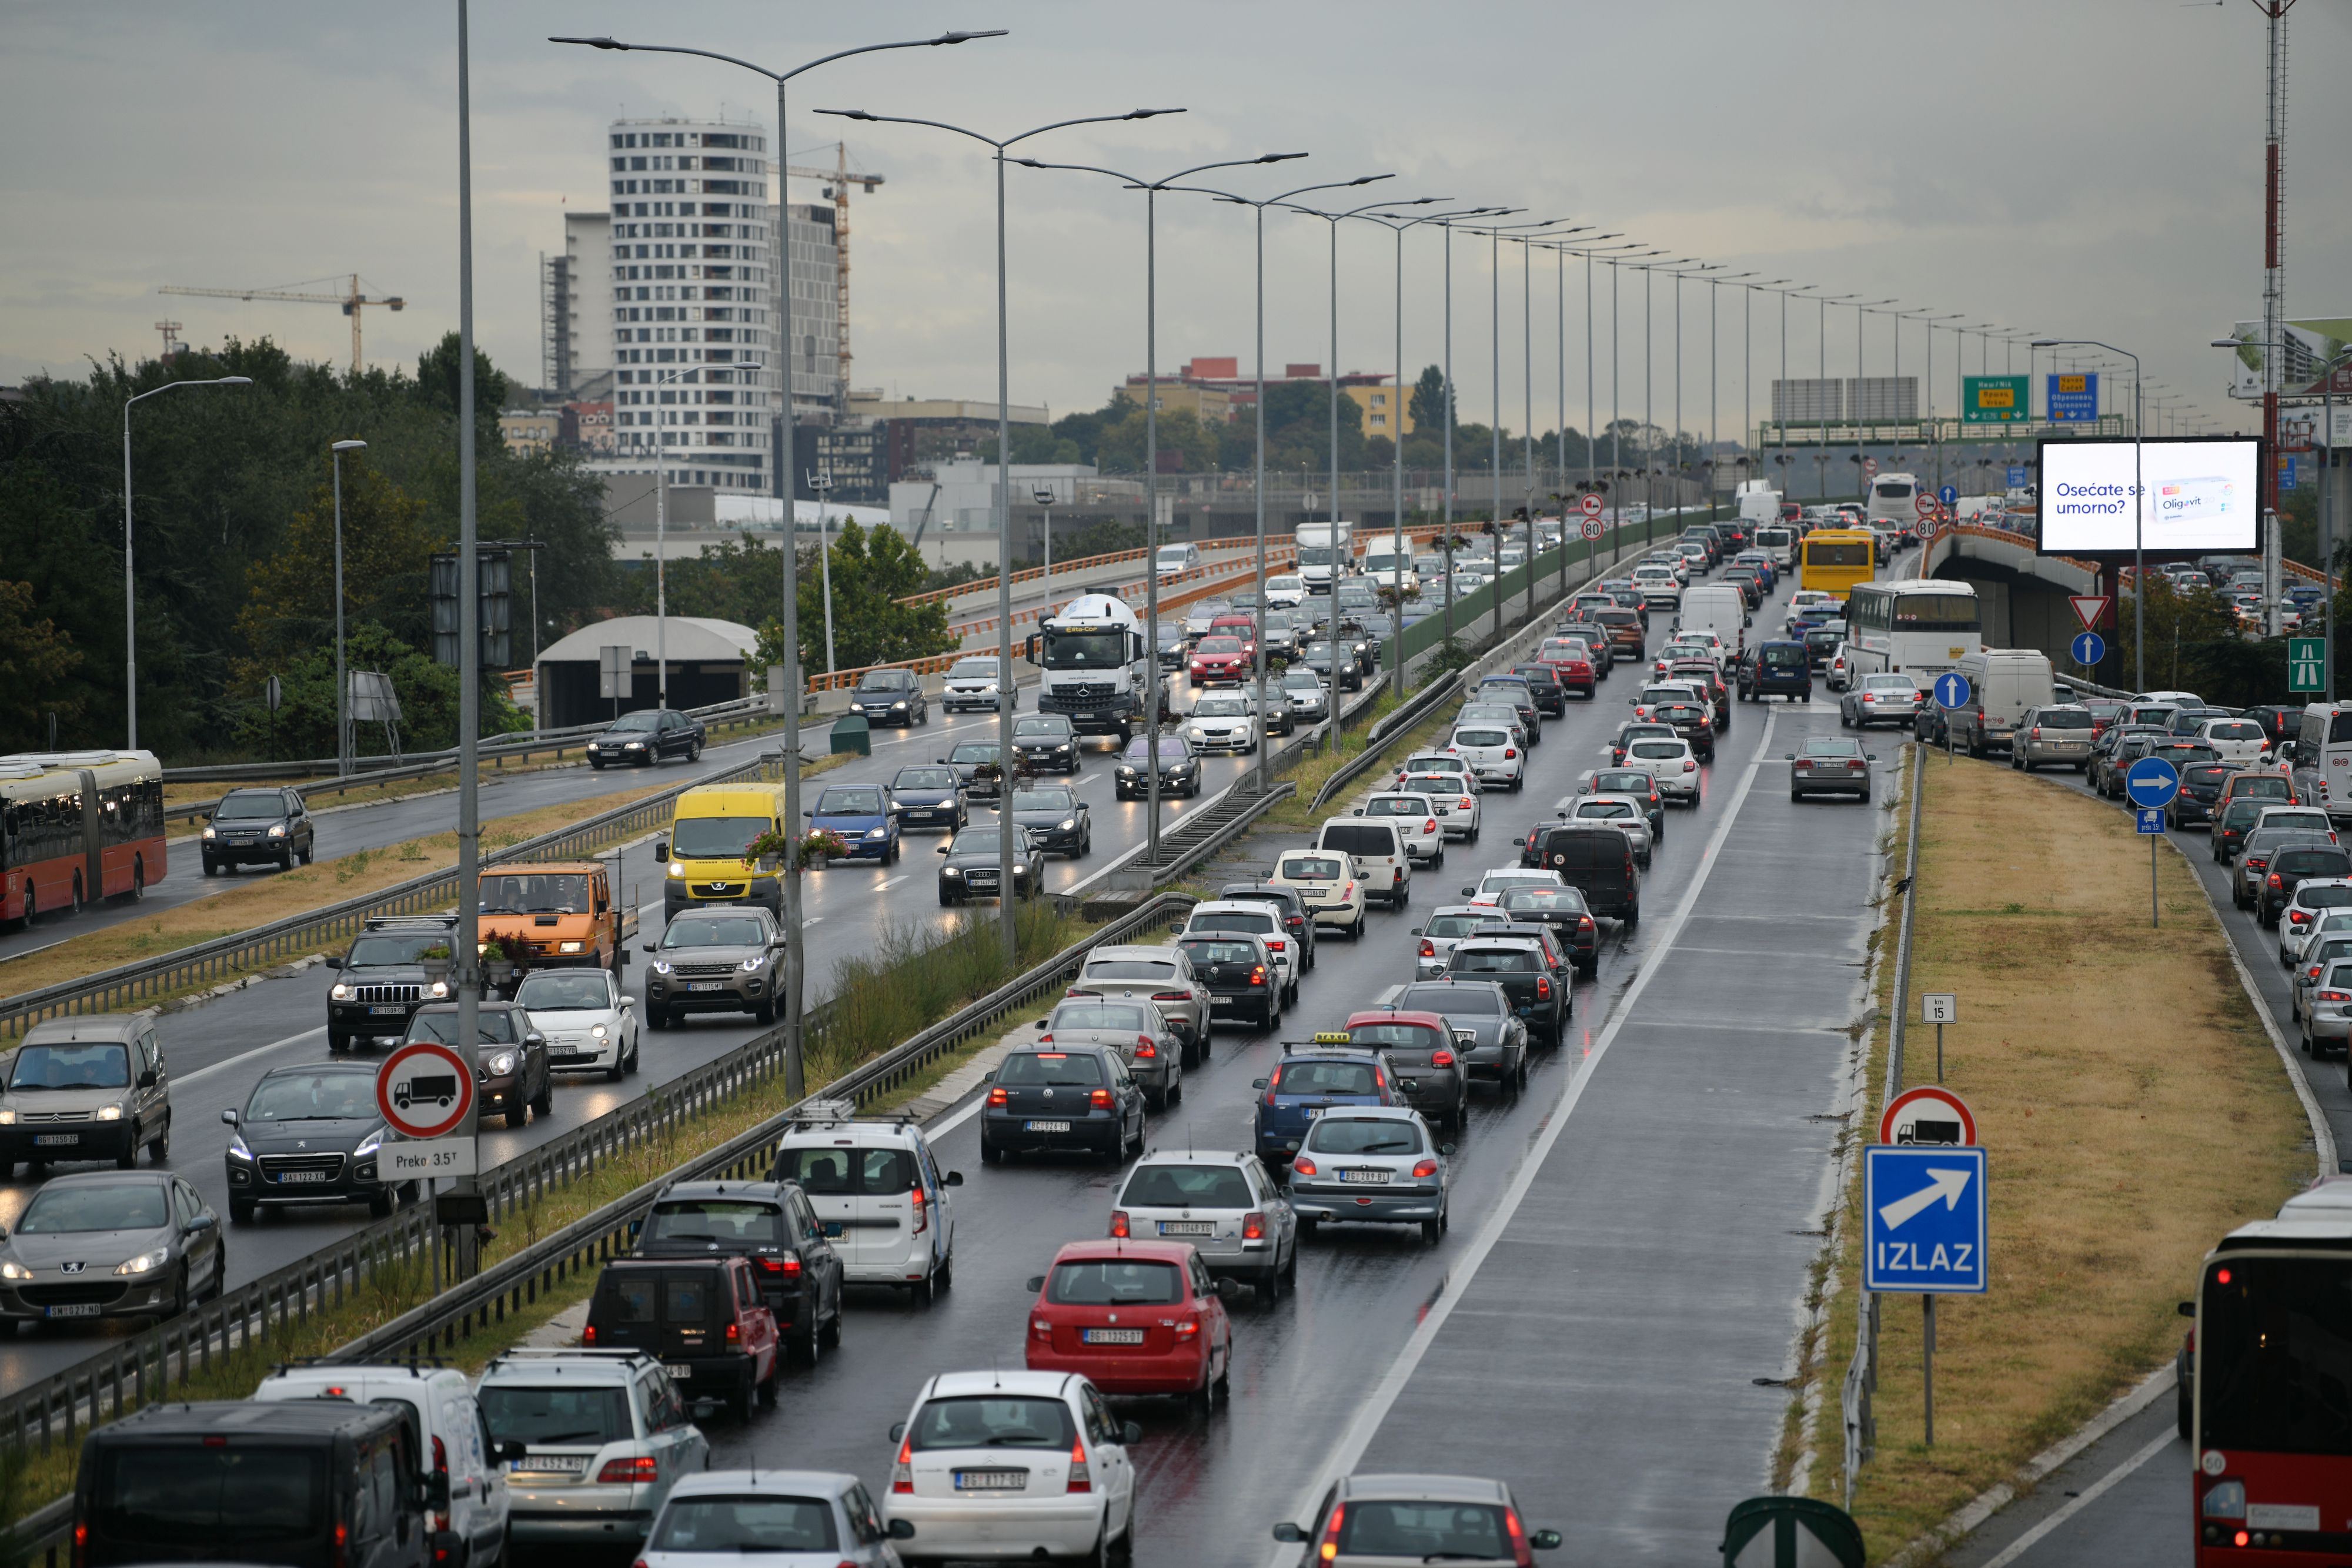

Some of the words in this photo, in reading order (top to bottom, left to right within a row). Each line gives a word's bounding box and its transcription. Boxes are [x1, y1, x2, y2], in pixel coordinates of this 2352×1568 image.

[2057, 483, 2123, 496] Osećate
[2057, 500, 2125, 514] umorno?
[1586, 524, 1599, 536] 80
[1920, 523, 1935, 534] 80
[2141, 824, 2151, 832] preko
[1934, 1008, 1944, 1018] 15
[397, 1155, 427, 1168] Preko
[299, 1172, 324, 1181] 122-XC
[1361, 1172, 1387, 1181] 289-BL
[1091, 1332, 1100, 1341] BG
[2204, 1457, 2222, 1470] 50
[964, 1475, 977, 1487] BG
